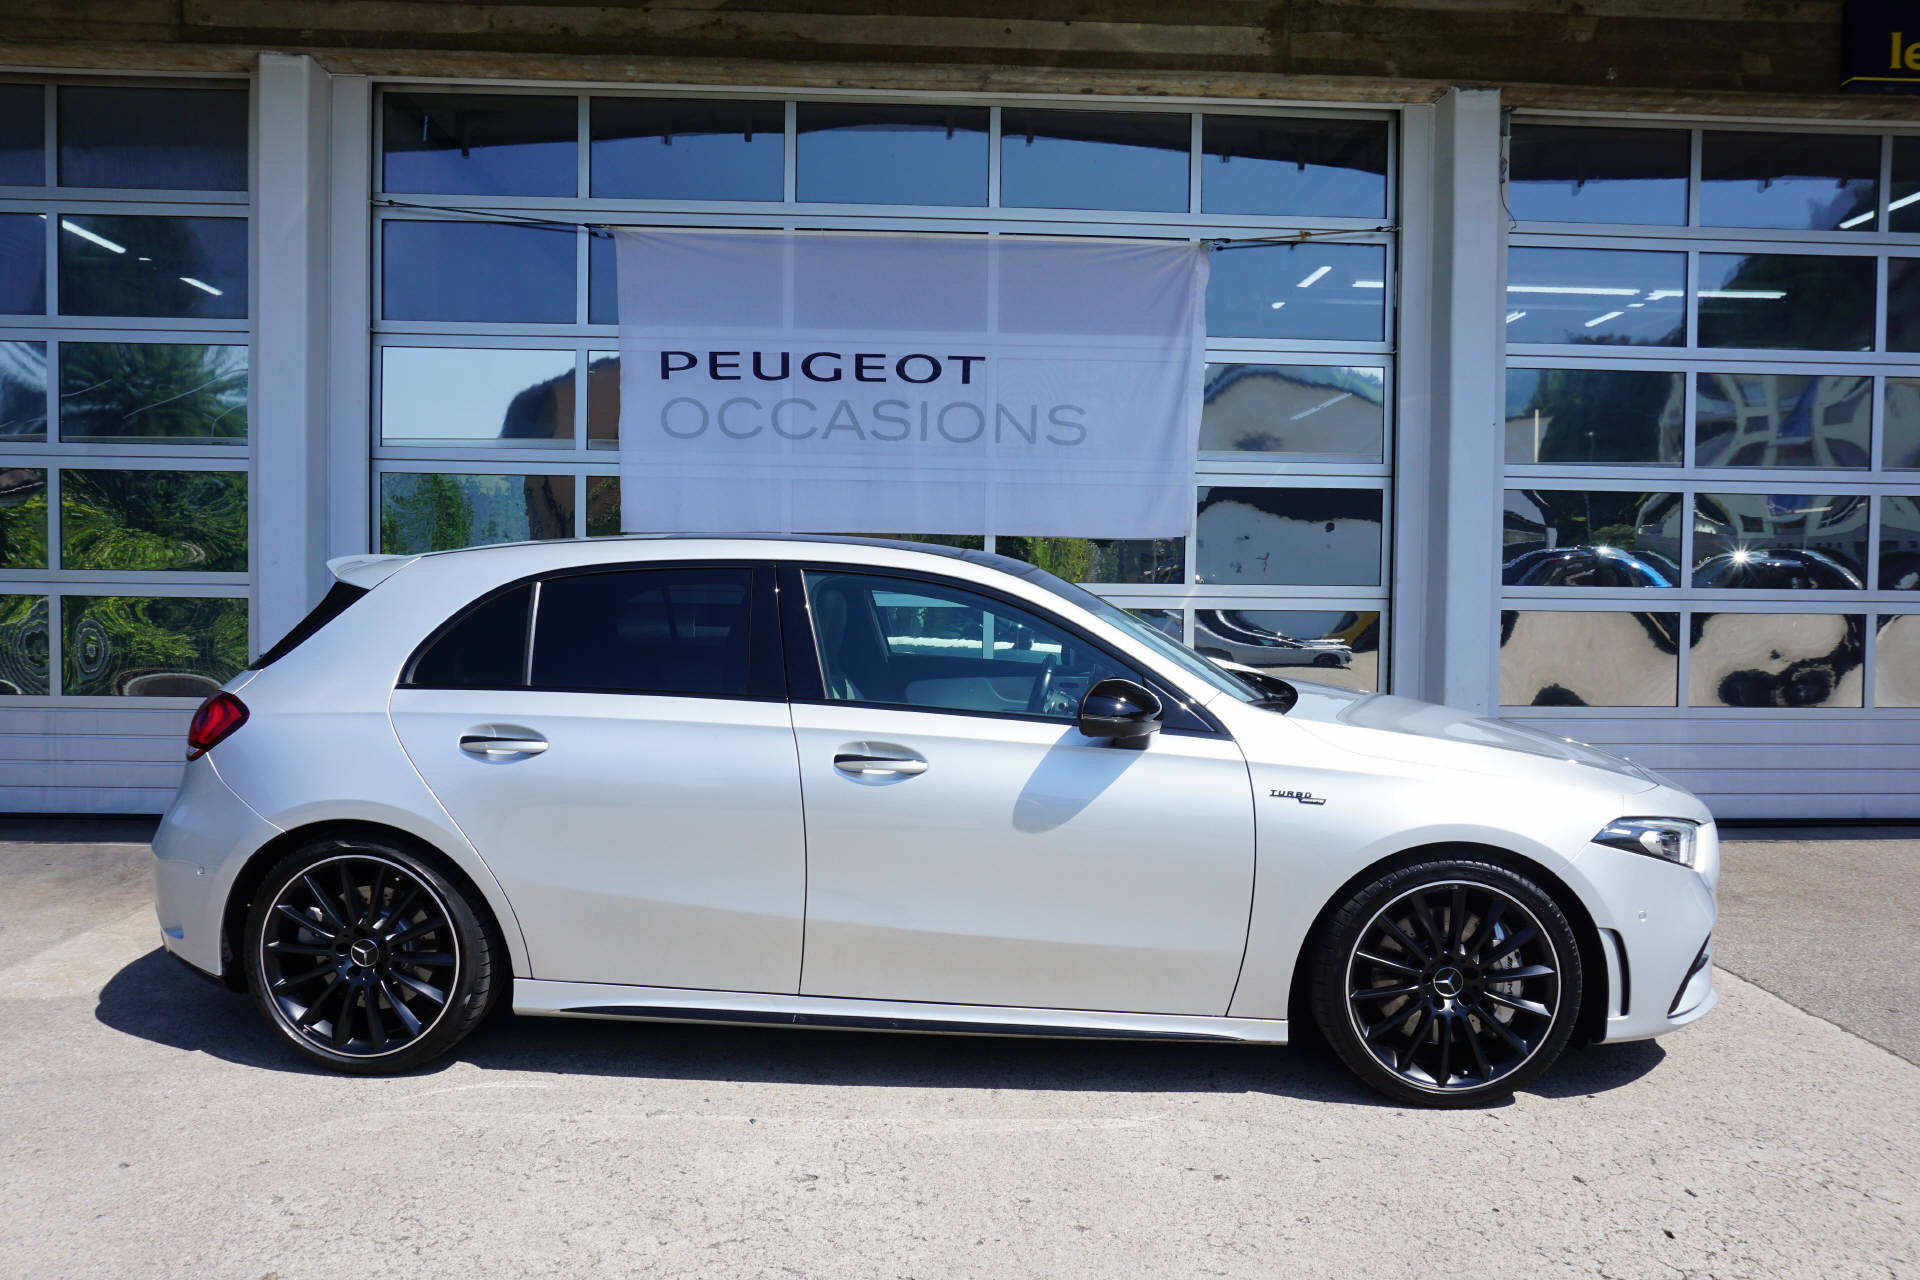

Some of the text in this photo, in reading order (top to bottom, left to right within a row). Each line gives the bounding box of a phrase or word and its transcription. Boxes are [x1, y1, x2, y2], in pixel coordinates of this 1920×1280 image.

[660, 350, 987, 385] PEUGEOT
[660, 396, 1088, 447] OCCASIONS
[1269, 789, 1312, 799] TURBO
